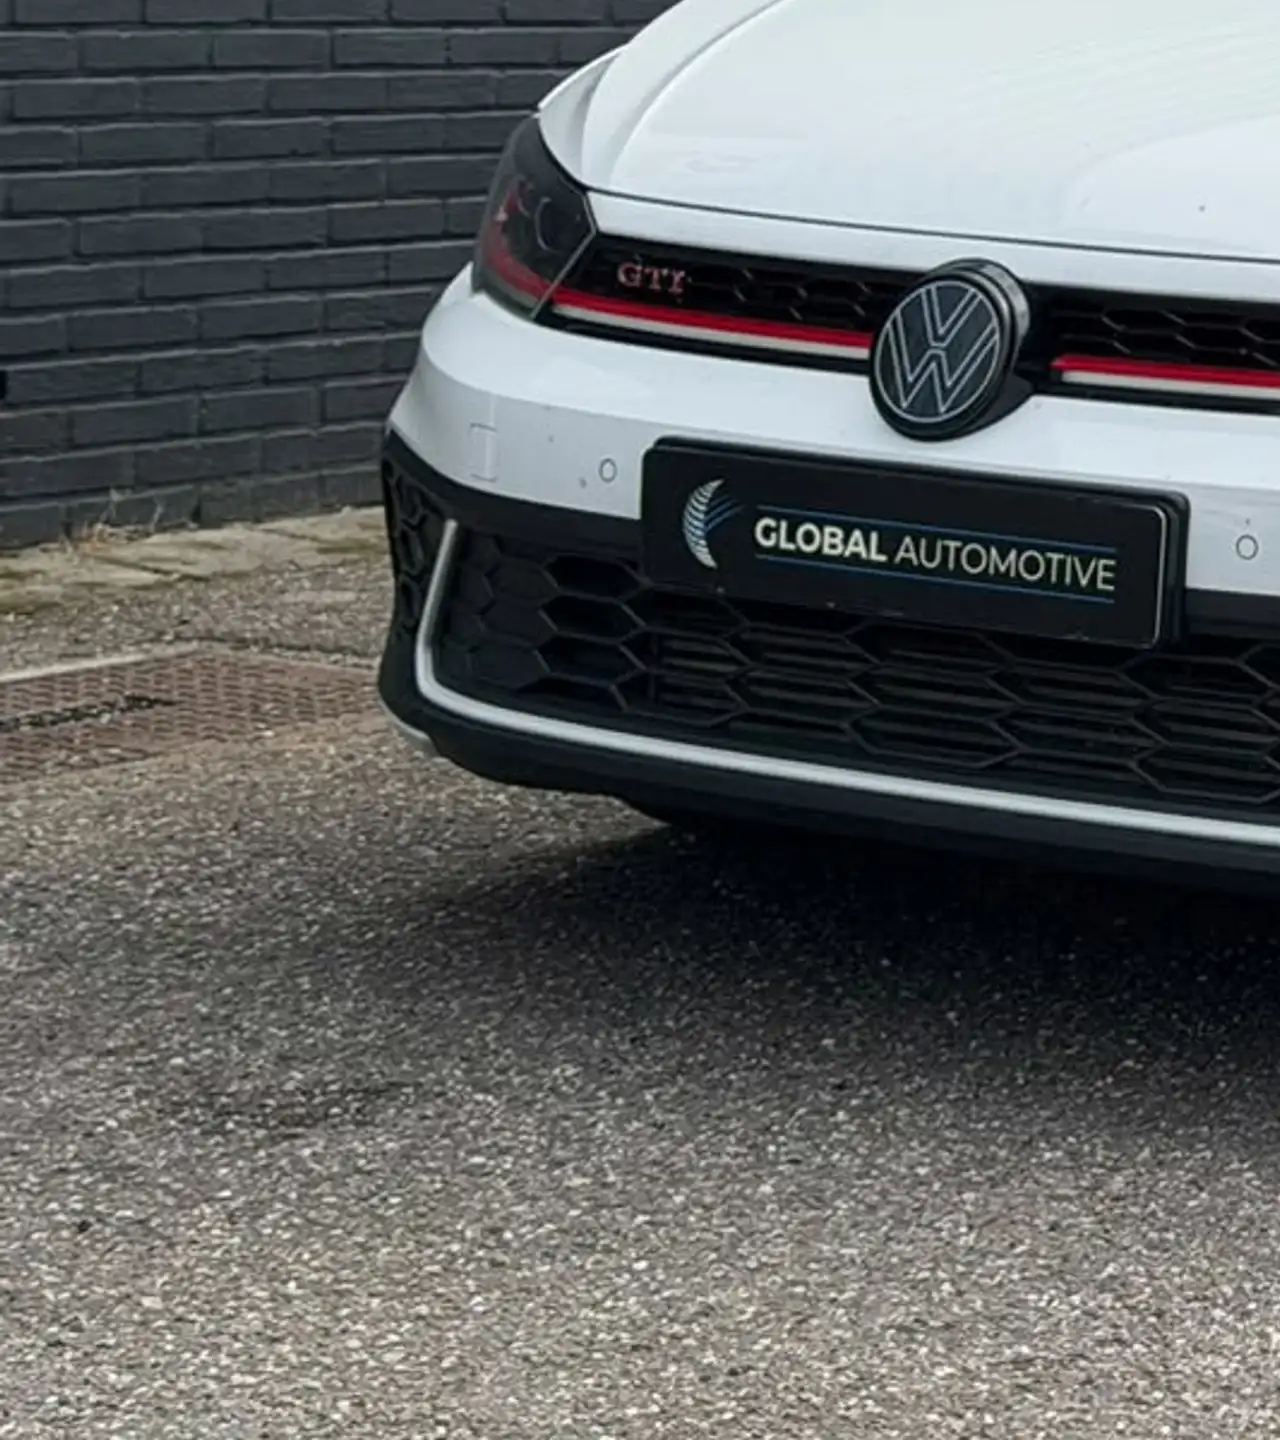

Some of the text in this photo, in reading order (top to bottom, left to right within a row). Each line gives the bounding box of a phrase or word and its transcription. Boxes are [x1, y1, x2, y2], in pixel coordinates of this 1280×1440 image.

[616, 261, 686, 294] GTI
[754, 516, 1116, 592] GLOBAL AUTOMOTIVE
